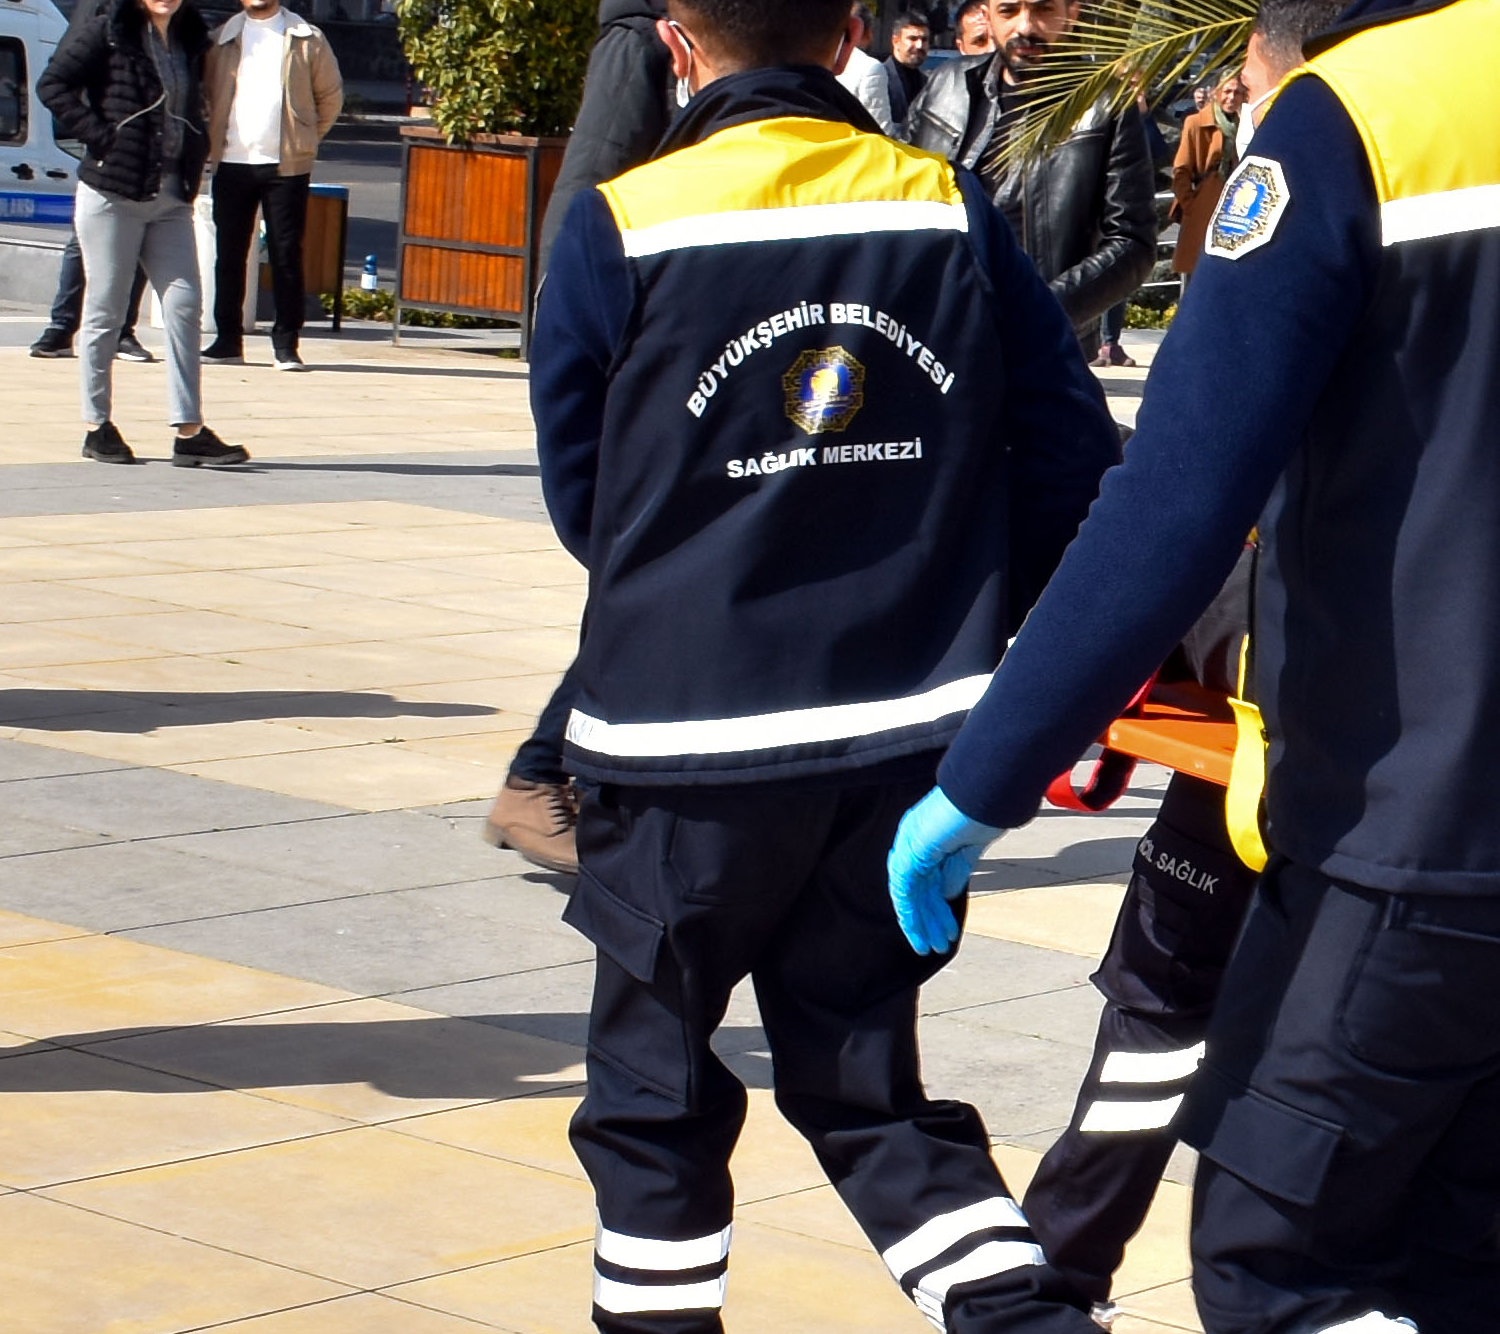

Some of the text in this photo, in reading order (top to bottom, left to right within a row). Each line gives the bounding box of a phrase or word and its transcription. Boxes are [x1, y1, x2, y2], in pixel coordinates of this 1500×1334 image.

[686, 299, 956, 418] BÜYÜKŞEHİR BELEDİYESİ
[822, 436, 923, 465] MERKEZİ
[1156, 852, 1220, 895] SAĞLIK
